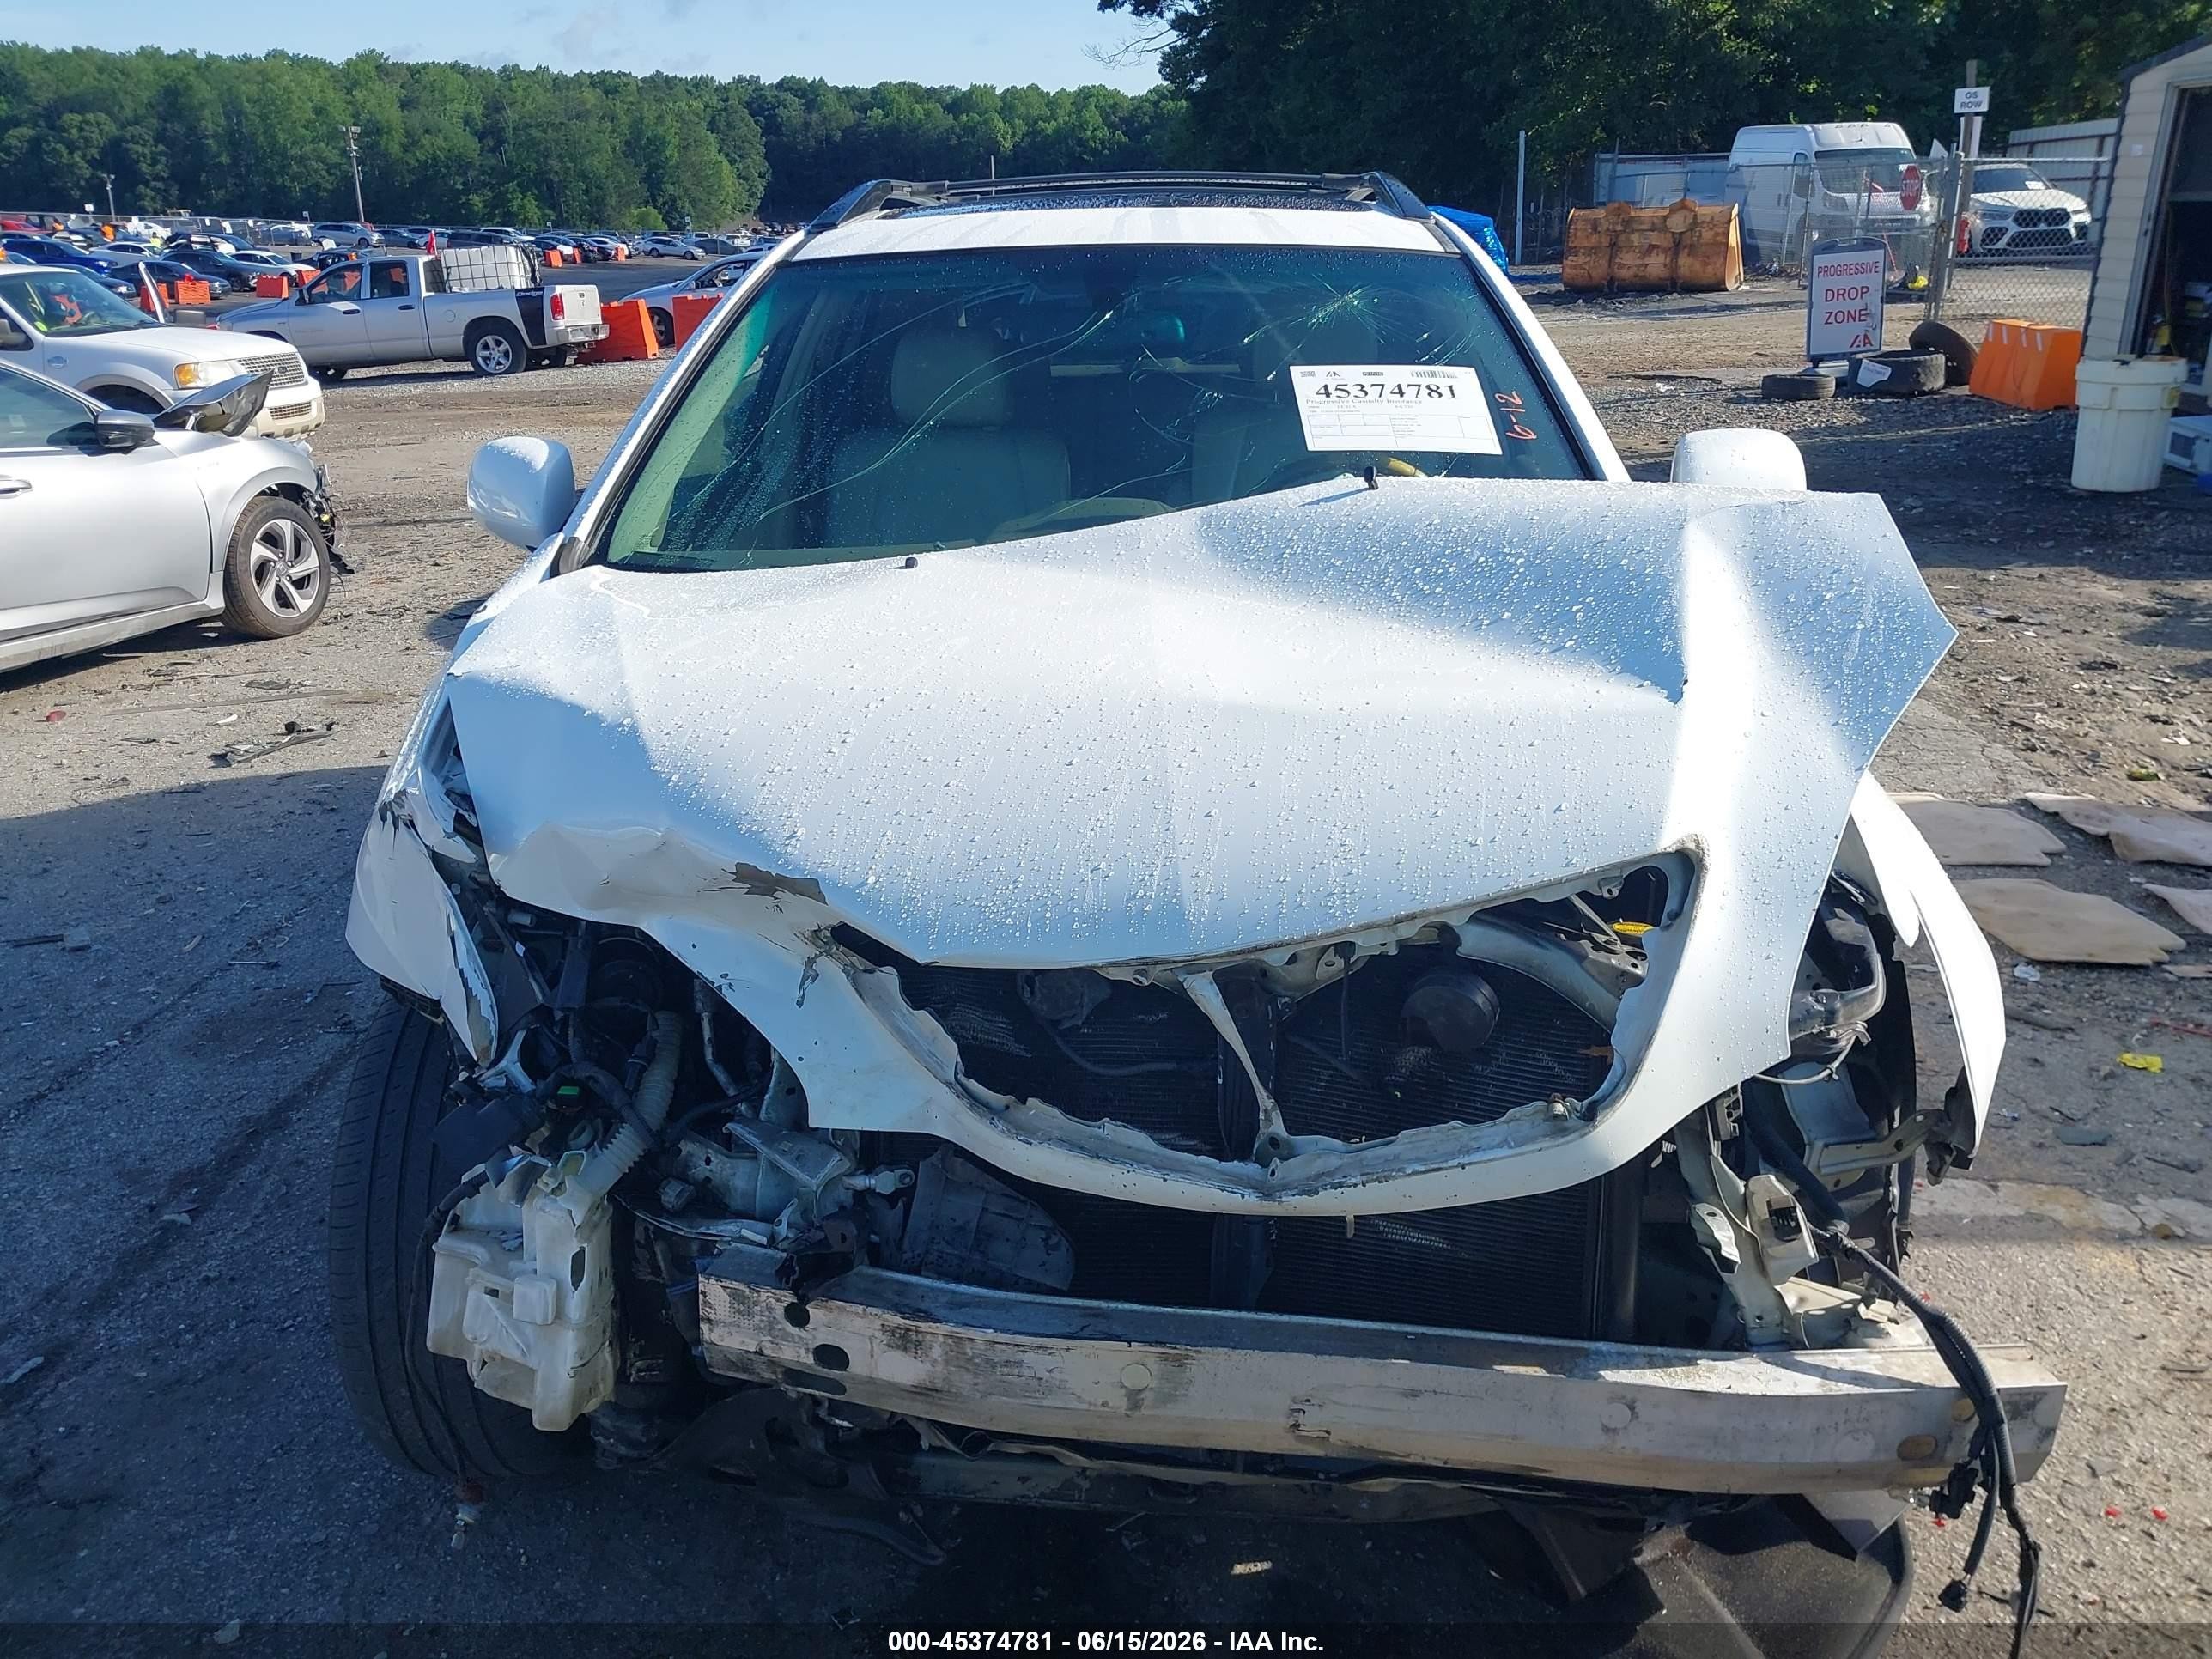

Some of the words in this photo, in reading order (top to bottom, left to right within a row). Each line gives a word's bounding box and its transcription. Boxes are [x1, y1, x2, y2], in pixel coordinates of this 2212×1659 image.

[1960, 100, 1983, 110] ROW
[1817, 261, 1880, 277] PROGRESSIVE
[1825, 286, 1869, 302] DROP
[1824, 308, 1868, 325] ZONE
[1316, 383, 1456, 399] 45374781
[1494, 391, 1537, 441] 6-12
